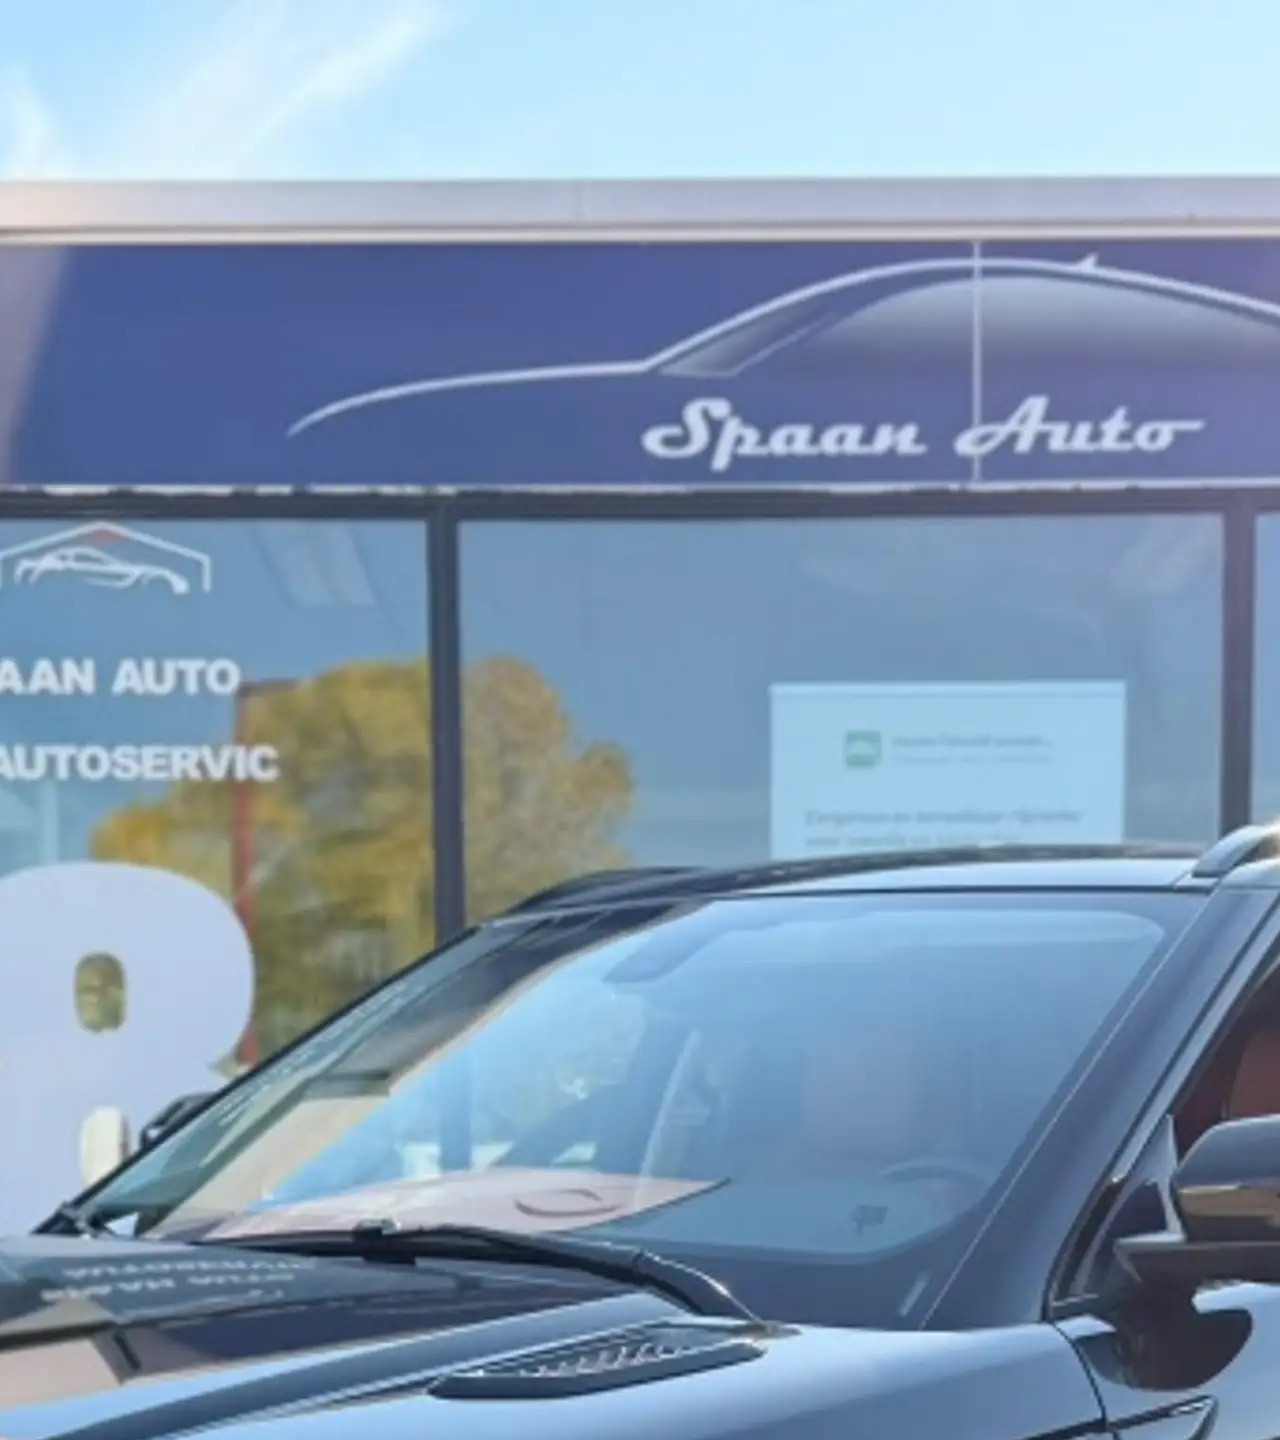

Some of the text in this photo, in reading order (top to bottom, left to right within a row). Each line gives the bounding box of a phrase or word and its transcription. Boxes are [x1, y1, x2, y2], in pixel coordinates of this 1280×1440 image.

[641, 395, 1206, 472] Spaan Auto
[112, 658, 240, 697] AUTO
